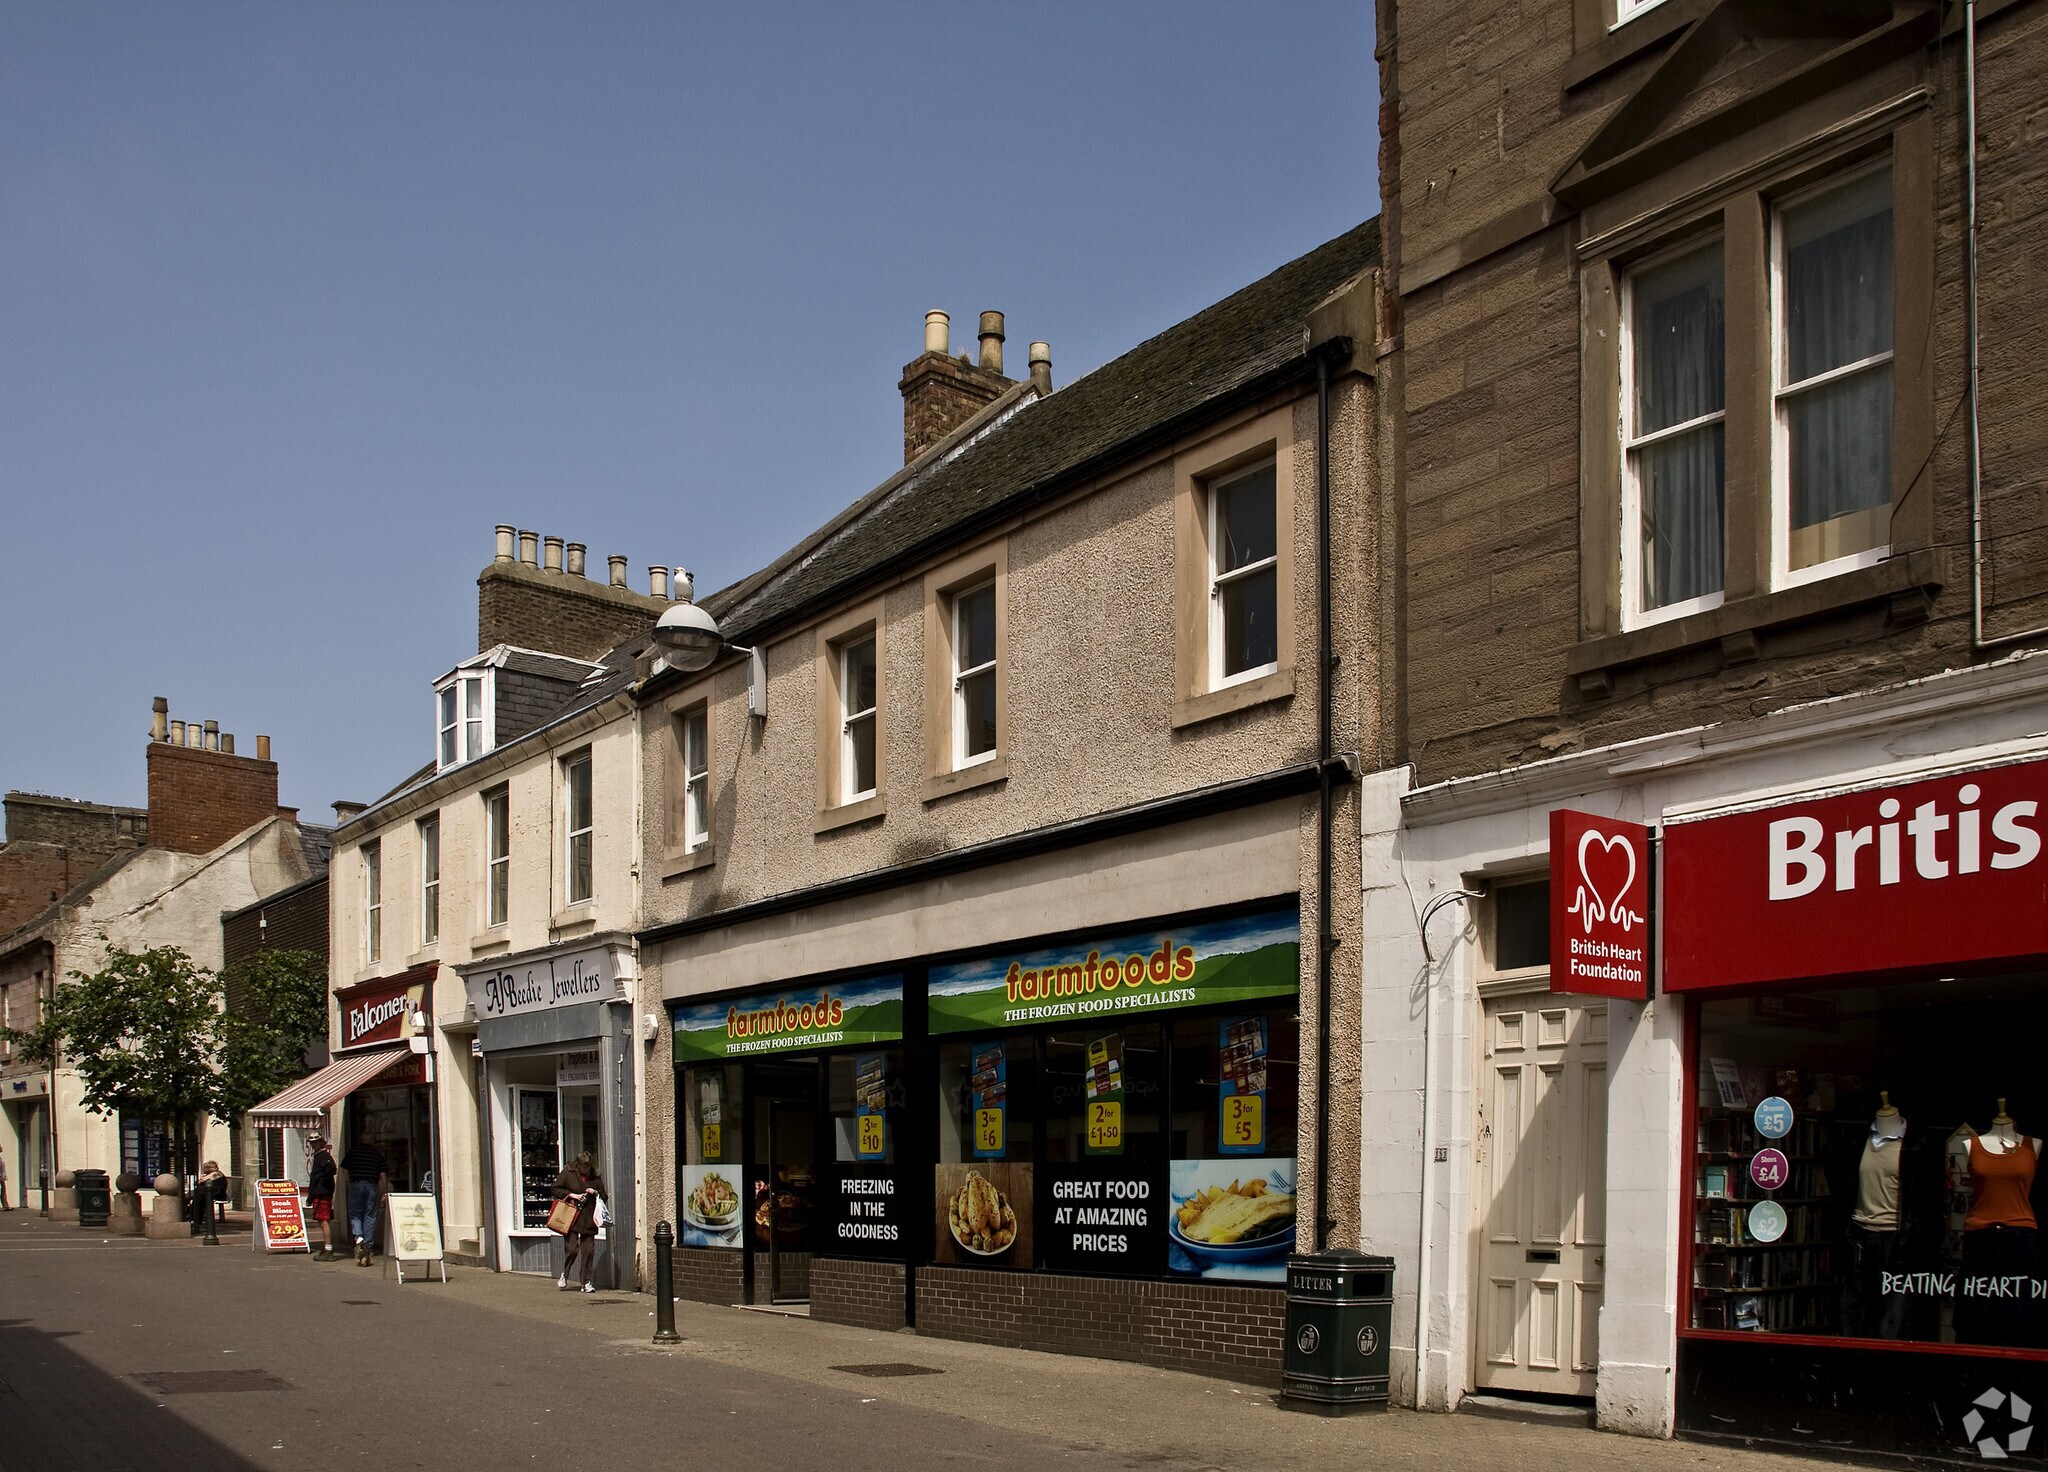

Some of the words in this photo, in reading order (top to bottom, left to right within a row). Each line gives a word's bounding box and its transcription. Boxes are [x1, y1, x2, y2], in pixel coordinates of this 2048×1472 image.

[1769, 783, 2042, 901] Britis
[1570, 938, 1609, 958] British
[1610, 943, 1642, 962] Heart
[1006, 939, 1195, 1002] farmfoods
[1570, 958, 1642, 983] Foundation
[549, 959, 600, 1005] Jewellers
[1004, 1009, 1027, 1021] THE
[1029, 1002, 1075, 1018] FROZEN
[1078, 998, 1113, 1014] FOOD
[1114, 987, 1196, 1008] SPECIALISTS
[350, 994, 407, 1041] Falconer
[727, 993, 844, 1038] farmfoods
[726, 1044, 741, 1053] THE
[741, 1040, 771, 1051] FROZEN
[771, 1036, 794, 1049] FOOD
[794, 1031, 844, 1046] SPECIALISTS
[1095, 1104, 1105, 1123] 2
[1105, 1109, 1114, 1118] for
[1232, 1098, 1242, 1119] 3
[1243, 1103, 1253, 1113] for
[864, 1117, 870, 1133] 3
[870, 1121, 878, 1129] for
[981, 1110, 989, 1128] 3
[989, 1114, 997, 1123] for
[1763, 1113, 1784, 1133] £5
[983, 1129, 996, 1147] £6
[1235, 1121, 1252, 1142] £5
[863, 1134, 879, 1150] £10
[1760, 1156, 1777, 1164] Shoes
[1758, 1164, 1780, 1184] £4
[841, 1179, 894, 1195] FREEZING
[1053, 1180, 1102, 1199] GREAT
[1106, 1180, 1150, 1199] FOOD
[271, 1199, 291, 1207] Steak
[850, 1201, 861, 1216] IN
[863, 1201, 885, 1217] THE
[1054, 1207, 1073, 1224] AT
[1076, 1207, 1147, 1226] AMAZING
[1756, 1216, 1778, 1237] £2
[837, 1222, 899, 1241] GOODNESS
[1073, 1233, 1128, 1253] PRICES
[1293, 1275, 1333, 1291] LITTER
[1881, 1271, 1956, 1297] BEATING
[1963, 1275, 2029, 1298] HEART
[2030, 1278, 2047, 1299] DI
